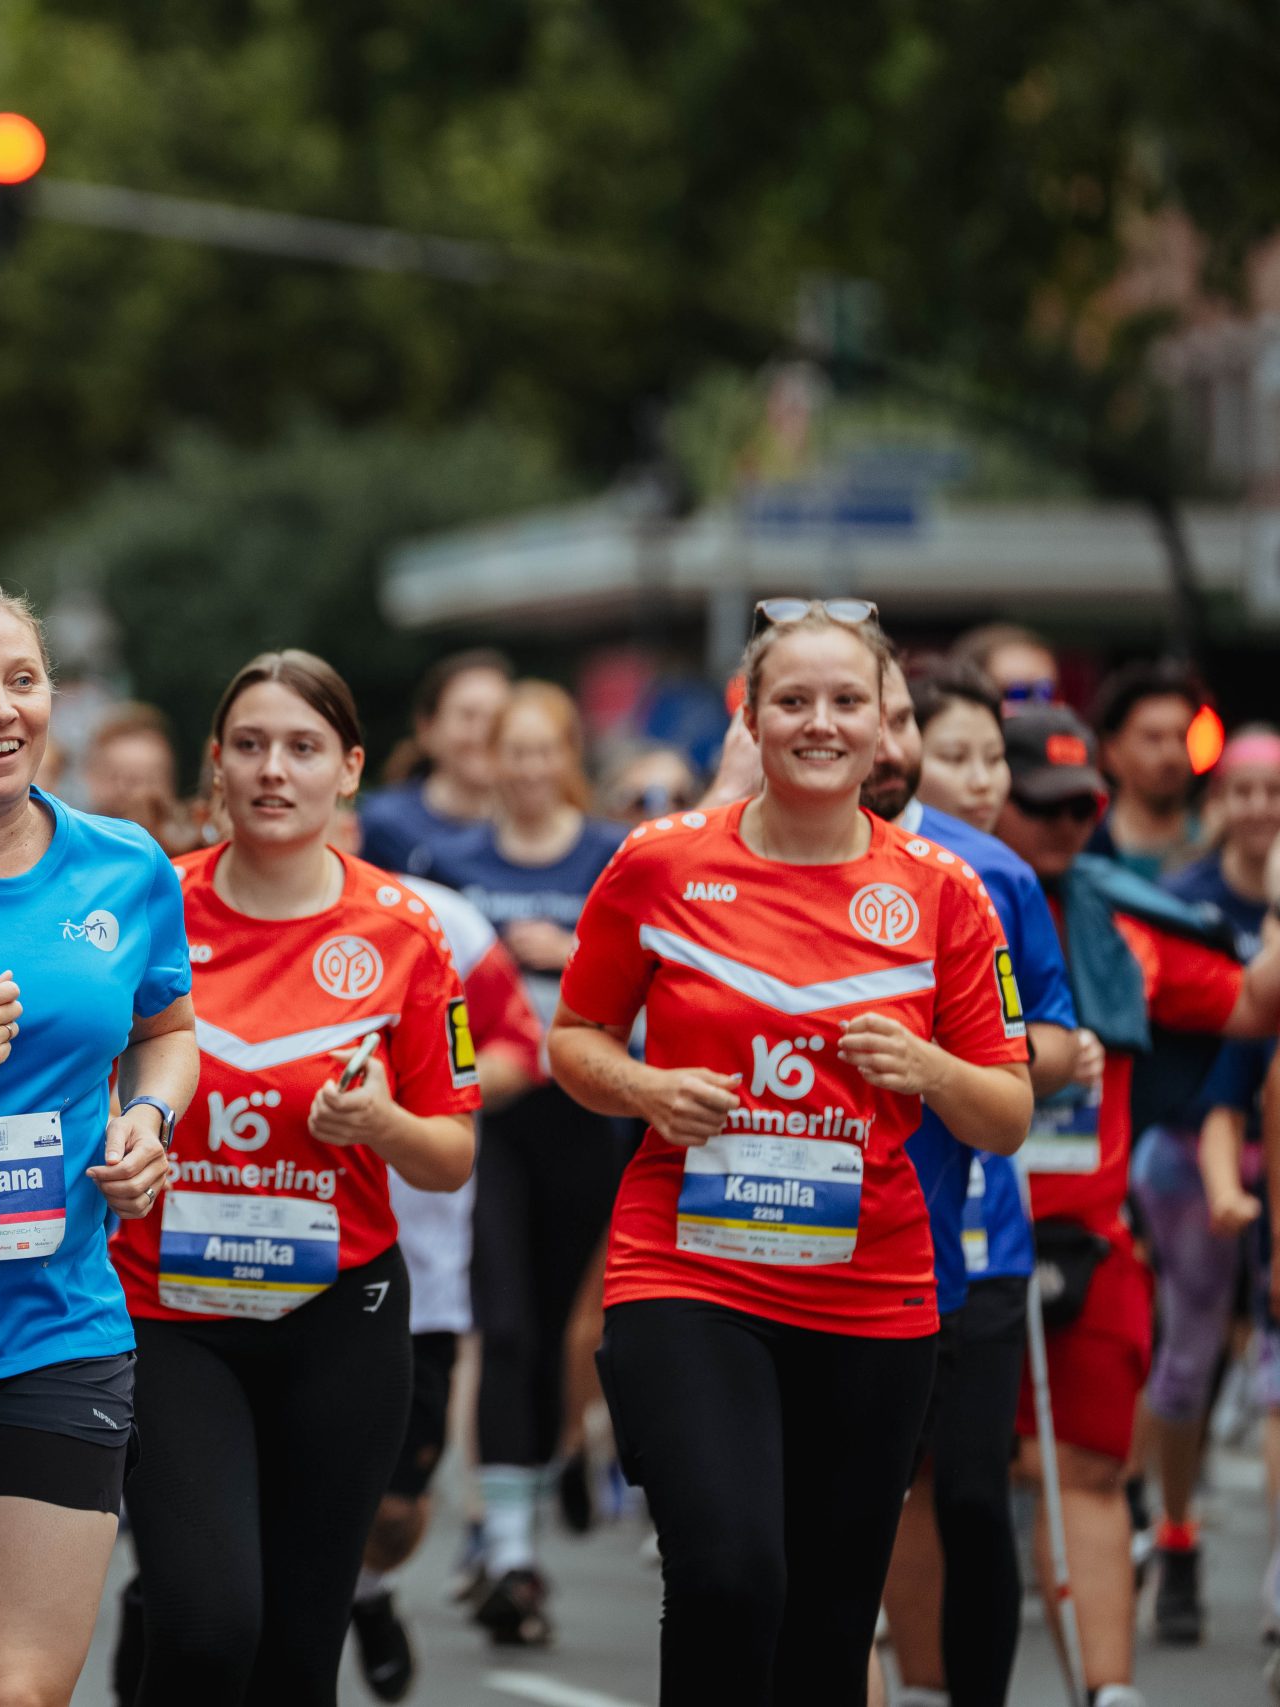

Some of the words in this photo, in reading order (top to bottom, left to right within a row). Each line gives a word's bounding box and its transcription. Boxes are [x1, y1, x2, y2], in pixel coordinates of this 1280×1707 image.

[682, 881, 737, 902] JAKO
[166, 1152, 337, 1200] ömmerling
[724, 1175, 816, 1208] Kamila
[203, 1236, 296, 1266] Annika
